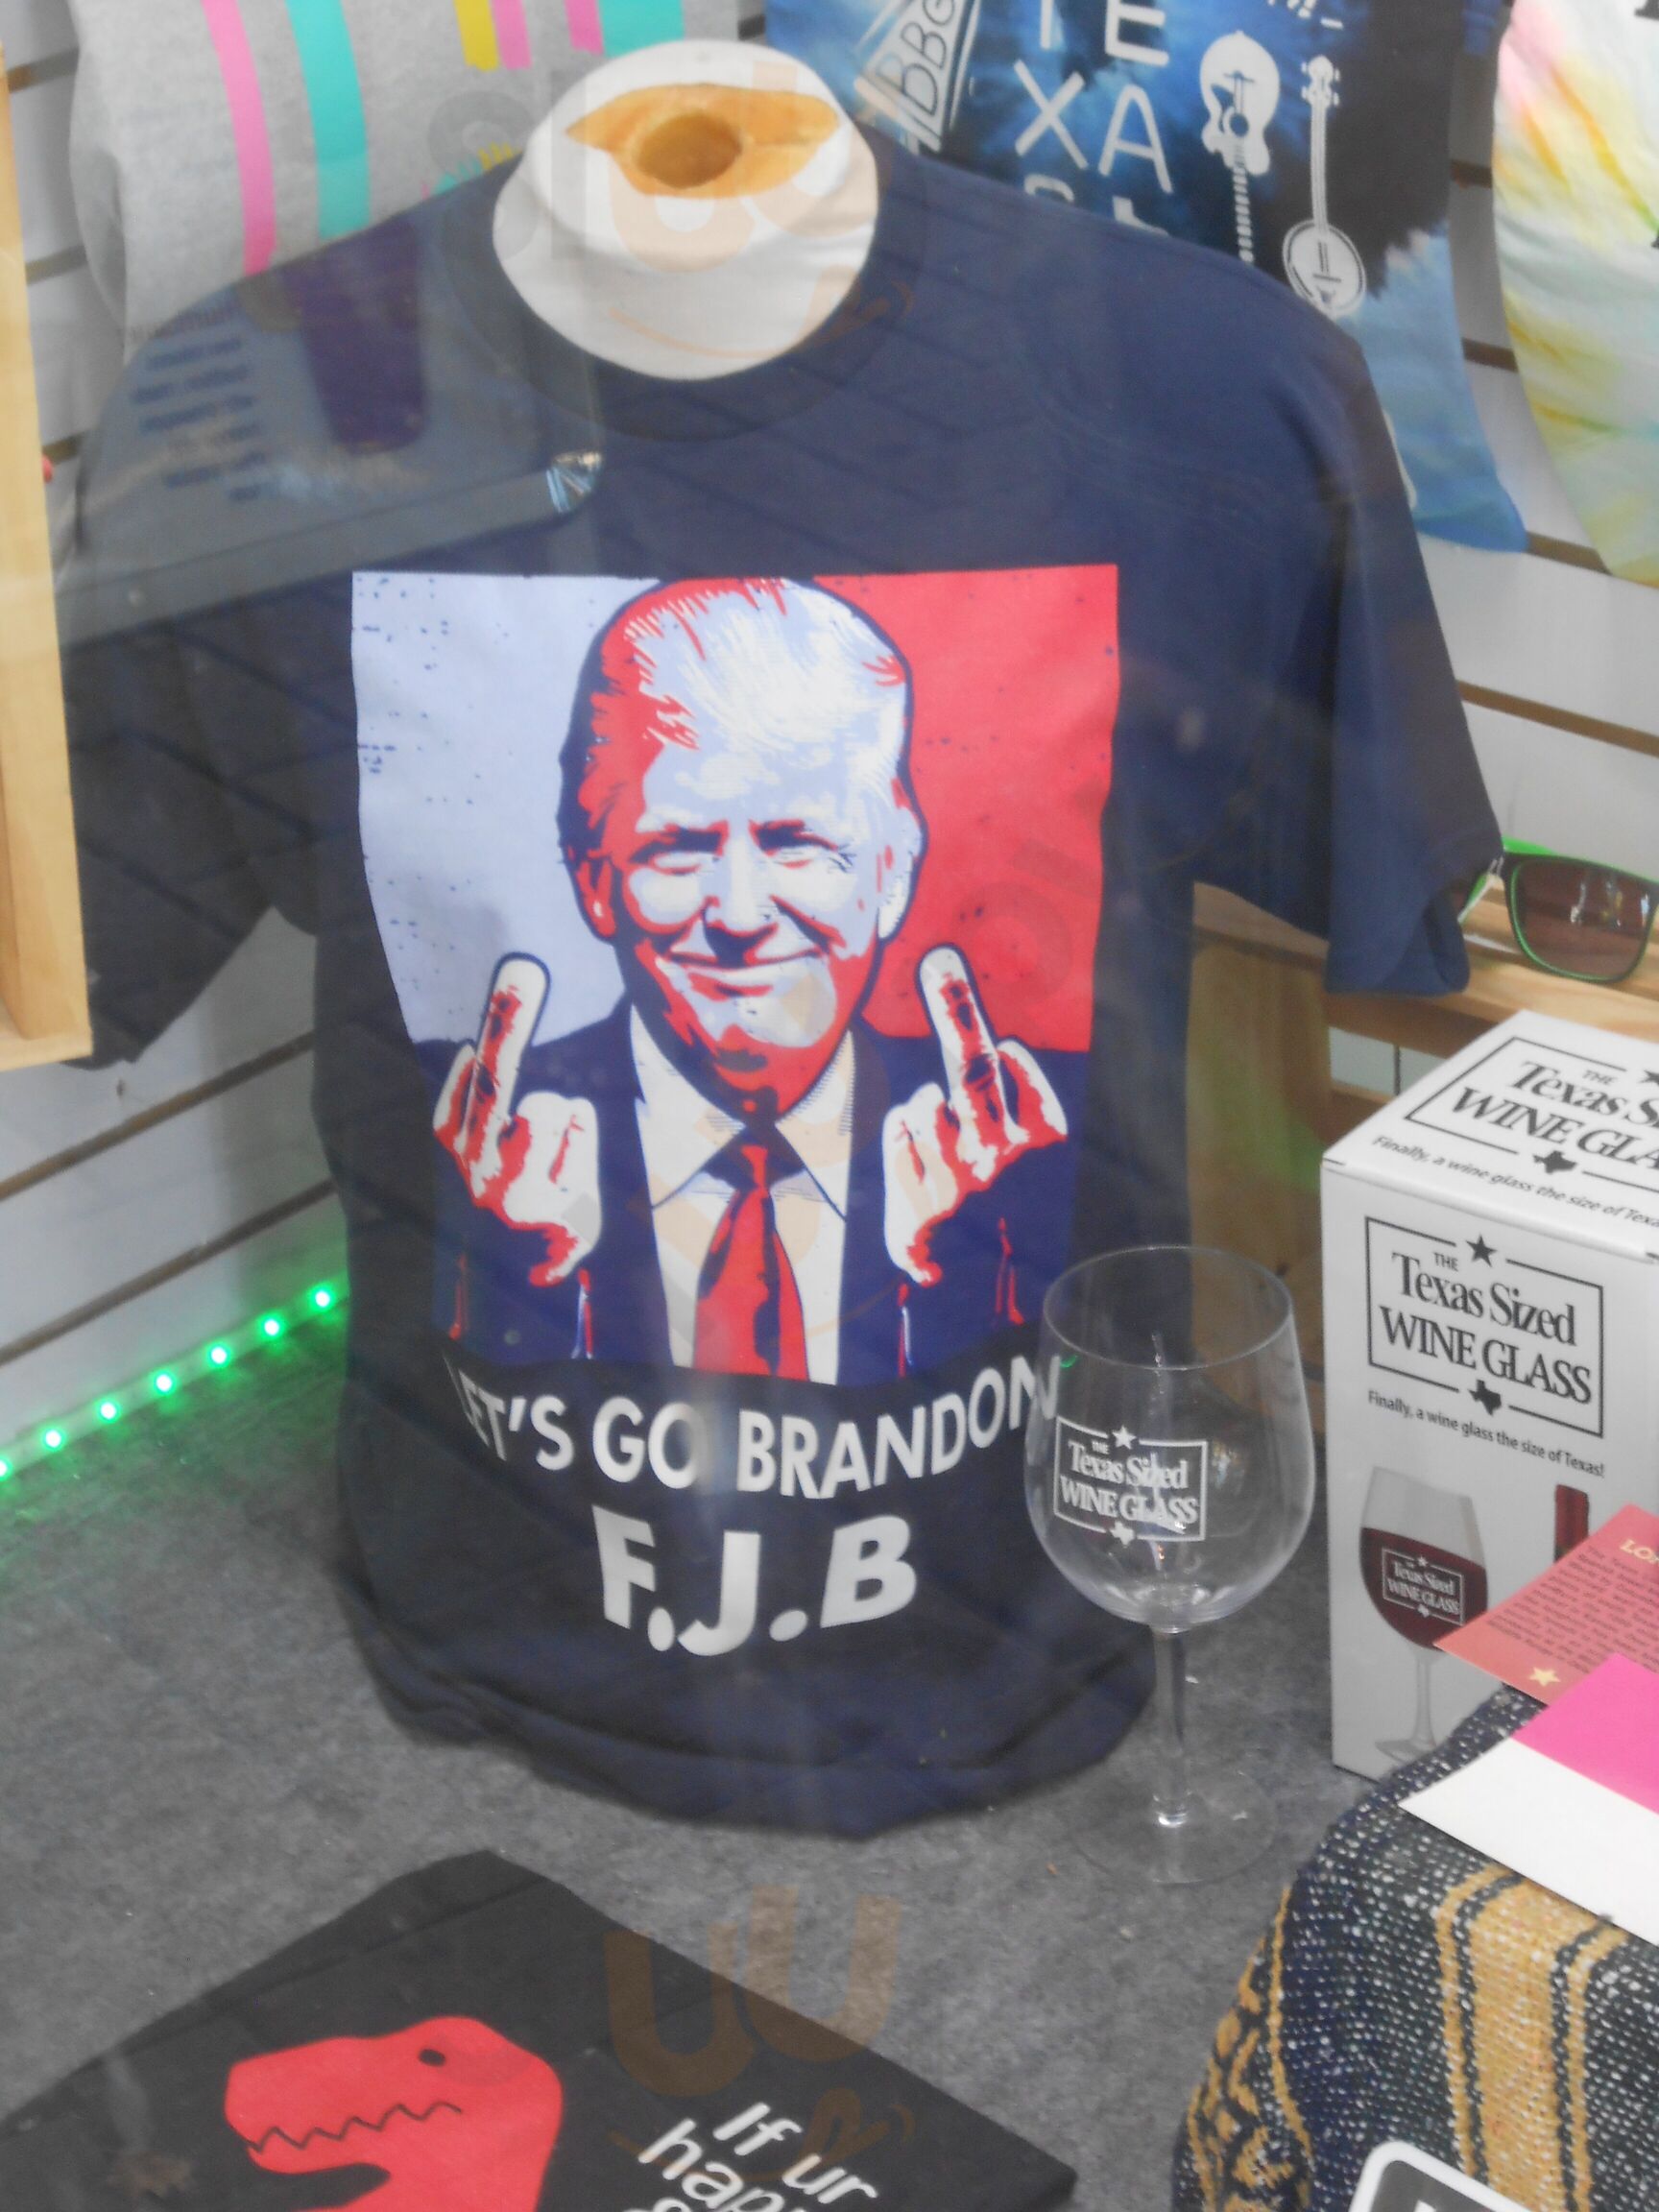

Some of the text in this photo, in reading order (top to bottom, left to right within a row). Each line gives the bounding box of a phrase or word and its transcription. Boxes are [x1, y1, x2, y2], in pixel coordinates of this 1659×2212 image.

[1452, 1087, 1585, 1144] WINE
[1506, 1061, 1628, 1116] Texas
[1372, 1136, 1430, 1163] Finally,
[1432, 1156, 1446, 1166] a
[1448, 1160, 1489, 1179] wine
[1491, 1171, 1535, 1192] glass
[1536, 1185, 1567, 1202] the
[1570, 1194, 1600, 1212] size
[1602, 1203, 1626, 1216] of
[1391, 1251, 1577, 1346] Texas Sized
[1433, 1252, 1458, 1271] THE
[1379, 1305, 1592, 1406] WINE GLASS
[591, 1396, 709, 1489] GO
[735, 1355, 1061, 1500] BRANDON
[1068, 1440, 1124, 1484] Texas
[1368, 1390, 1605, 1479] Finally, a wine glass the size of Texas!
[1060, 1475, 1119, 1518] WINE
[591, 1504, 918, 1656] F.J.B
[713, 2101, 878, 2204] If ur
